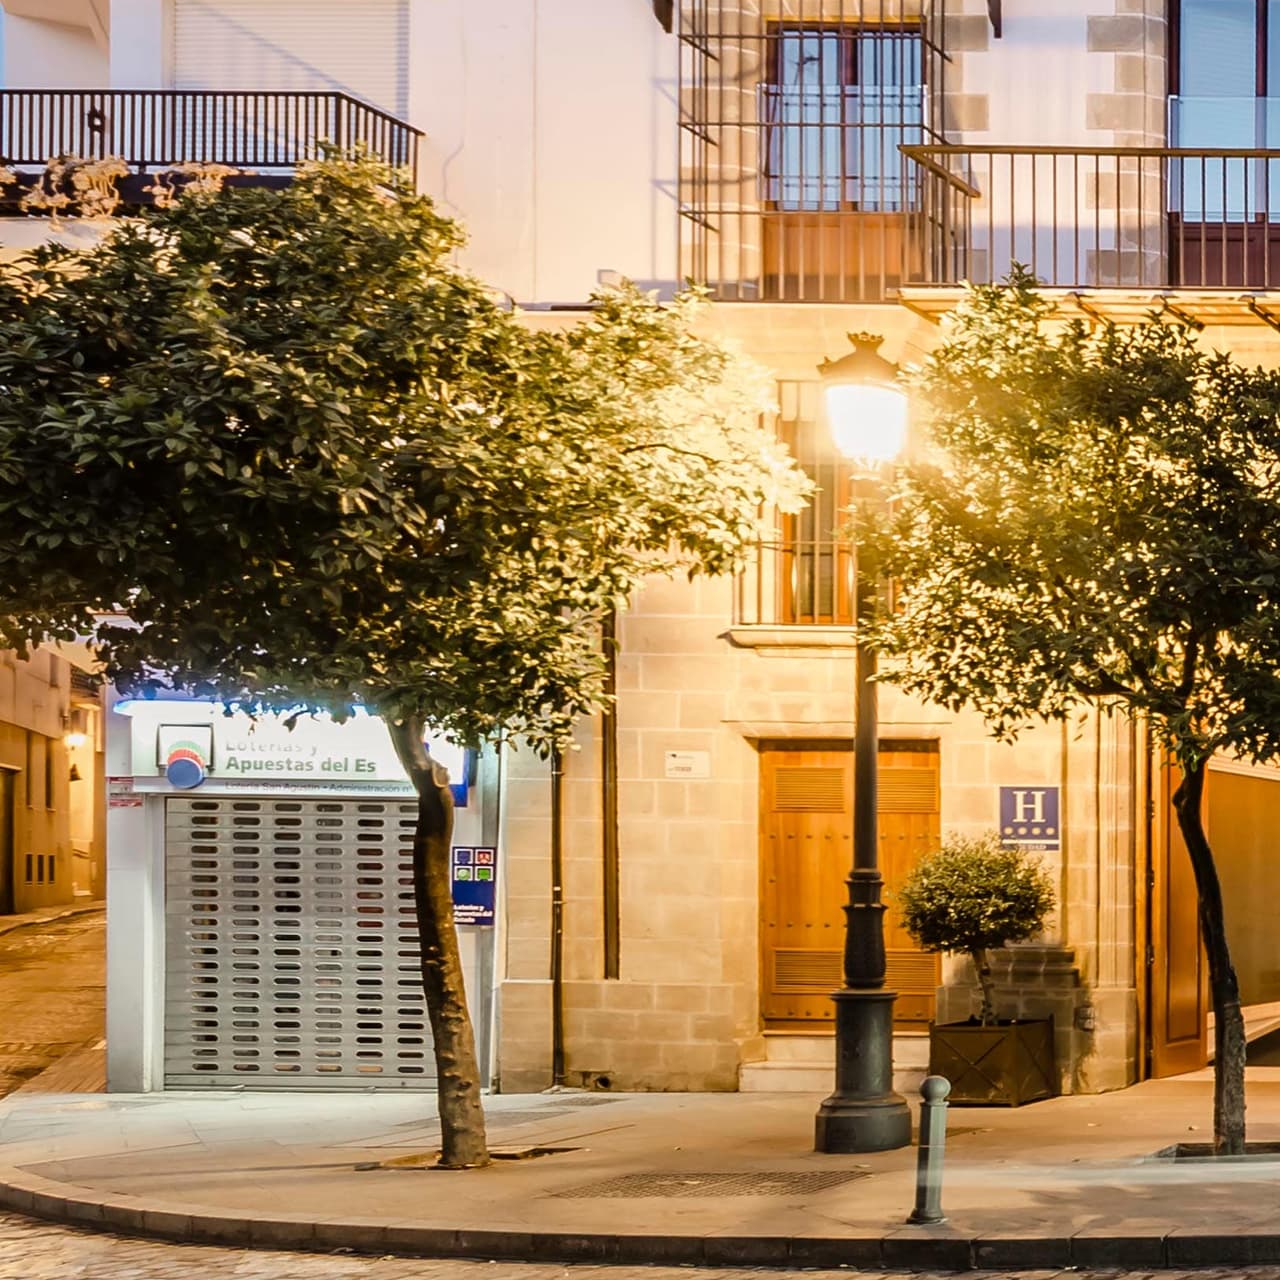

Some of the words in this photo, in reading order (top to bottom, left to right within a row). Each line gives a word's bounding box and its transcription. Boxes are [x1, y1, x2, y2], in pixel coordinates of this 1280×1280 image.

[225, 756, 314, 773] Apuestas
[321, 757, 348, 772] del
[1012, 791, 1046, 823] H
